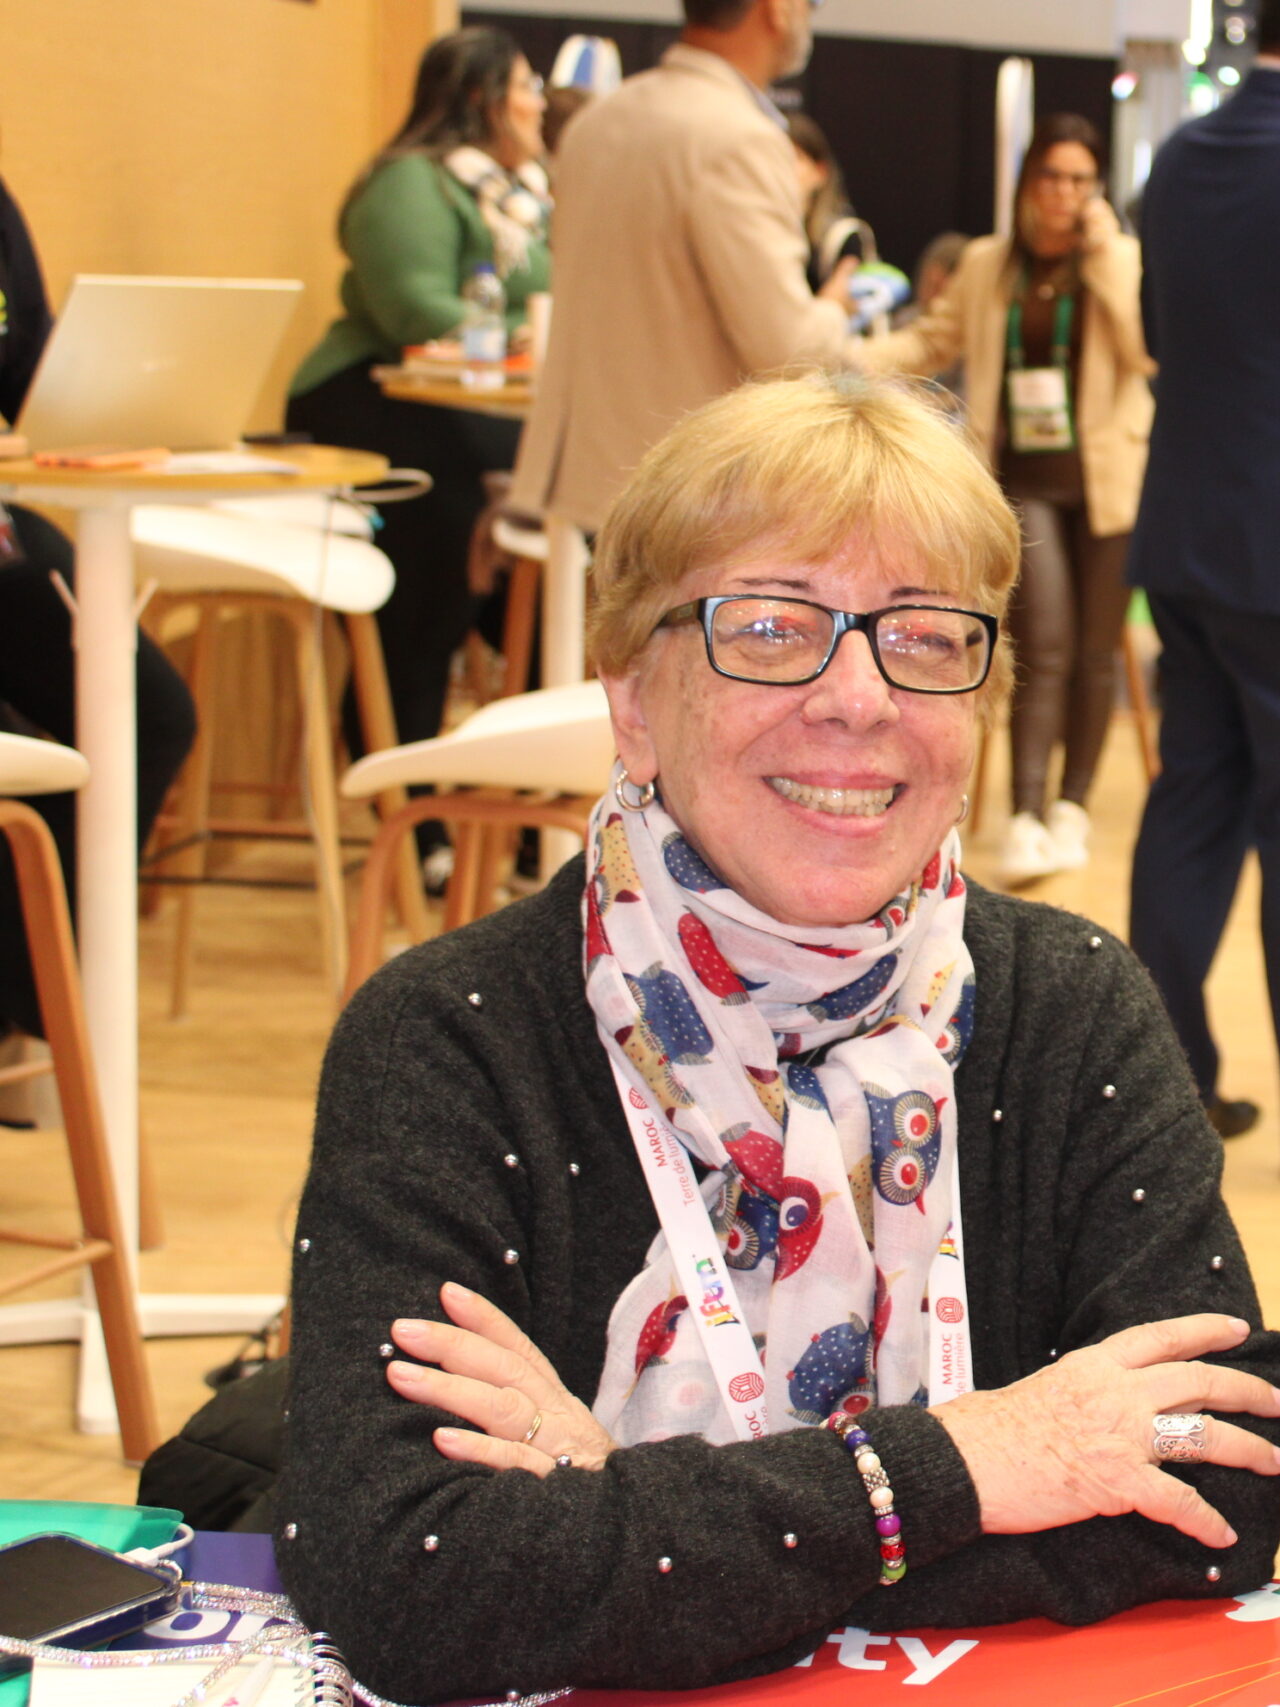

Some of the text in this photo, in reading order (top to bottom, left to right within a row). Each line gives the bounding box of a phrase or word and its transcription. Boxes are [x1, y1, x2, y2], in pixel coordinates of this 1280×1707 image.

[643, 1117, 668, 1167] MAROC
[672, 1160, 685, 1174] de
[678, 1176, 695, 1207] Terre
[942, 1332, 953, 1385] MAROC
[744, 1410, 766, 1441] ROC
[793, 1626, 980, 1685] ty
